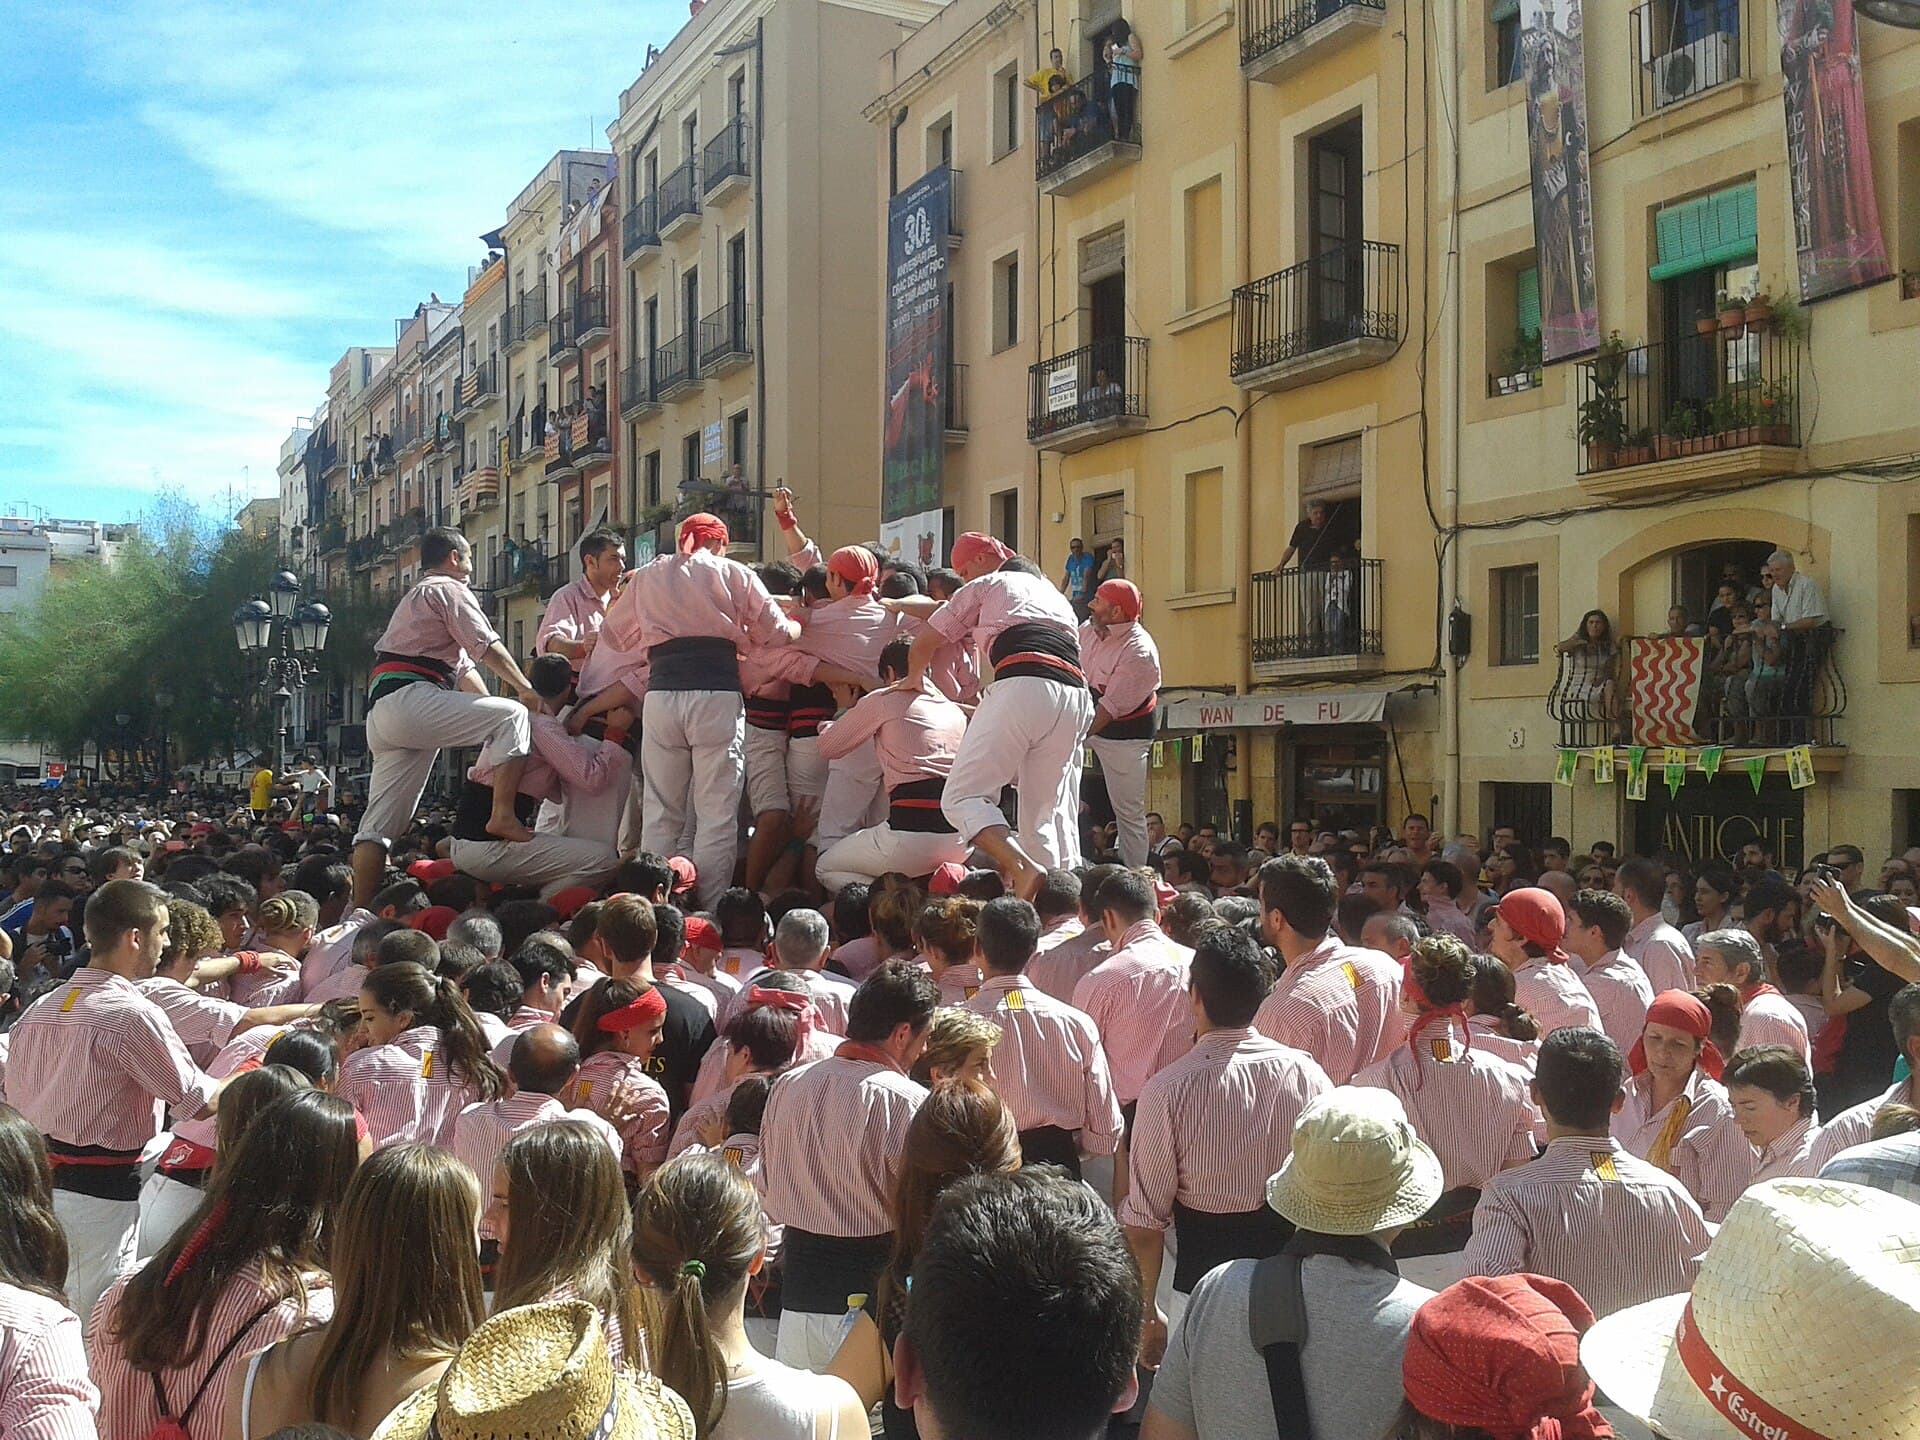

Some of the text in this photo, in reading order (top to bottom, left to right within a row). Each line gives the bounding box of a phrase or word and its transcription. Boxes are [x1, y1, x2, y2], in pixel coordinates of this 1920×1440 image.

[1200, 702, 1341, 724] WAN DE FU
[1513, 732, 1519, 744] 5
